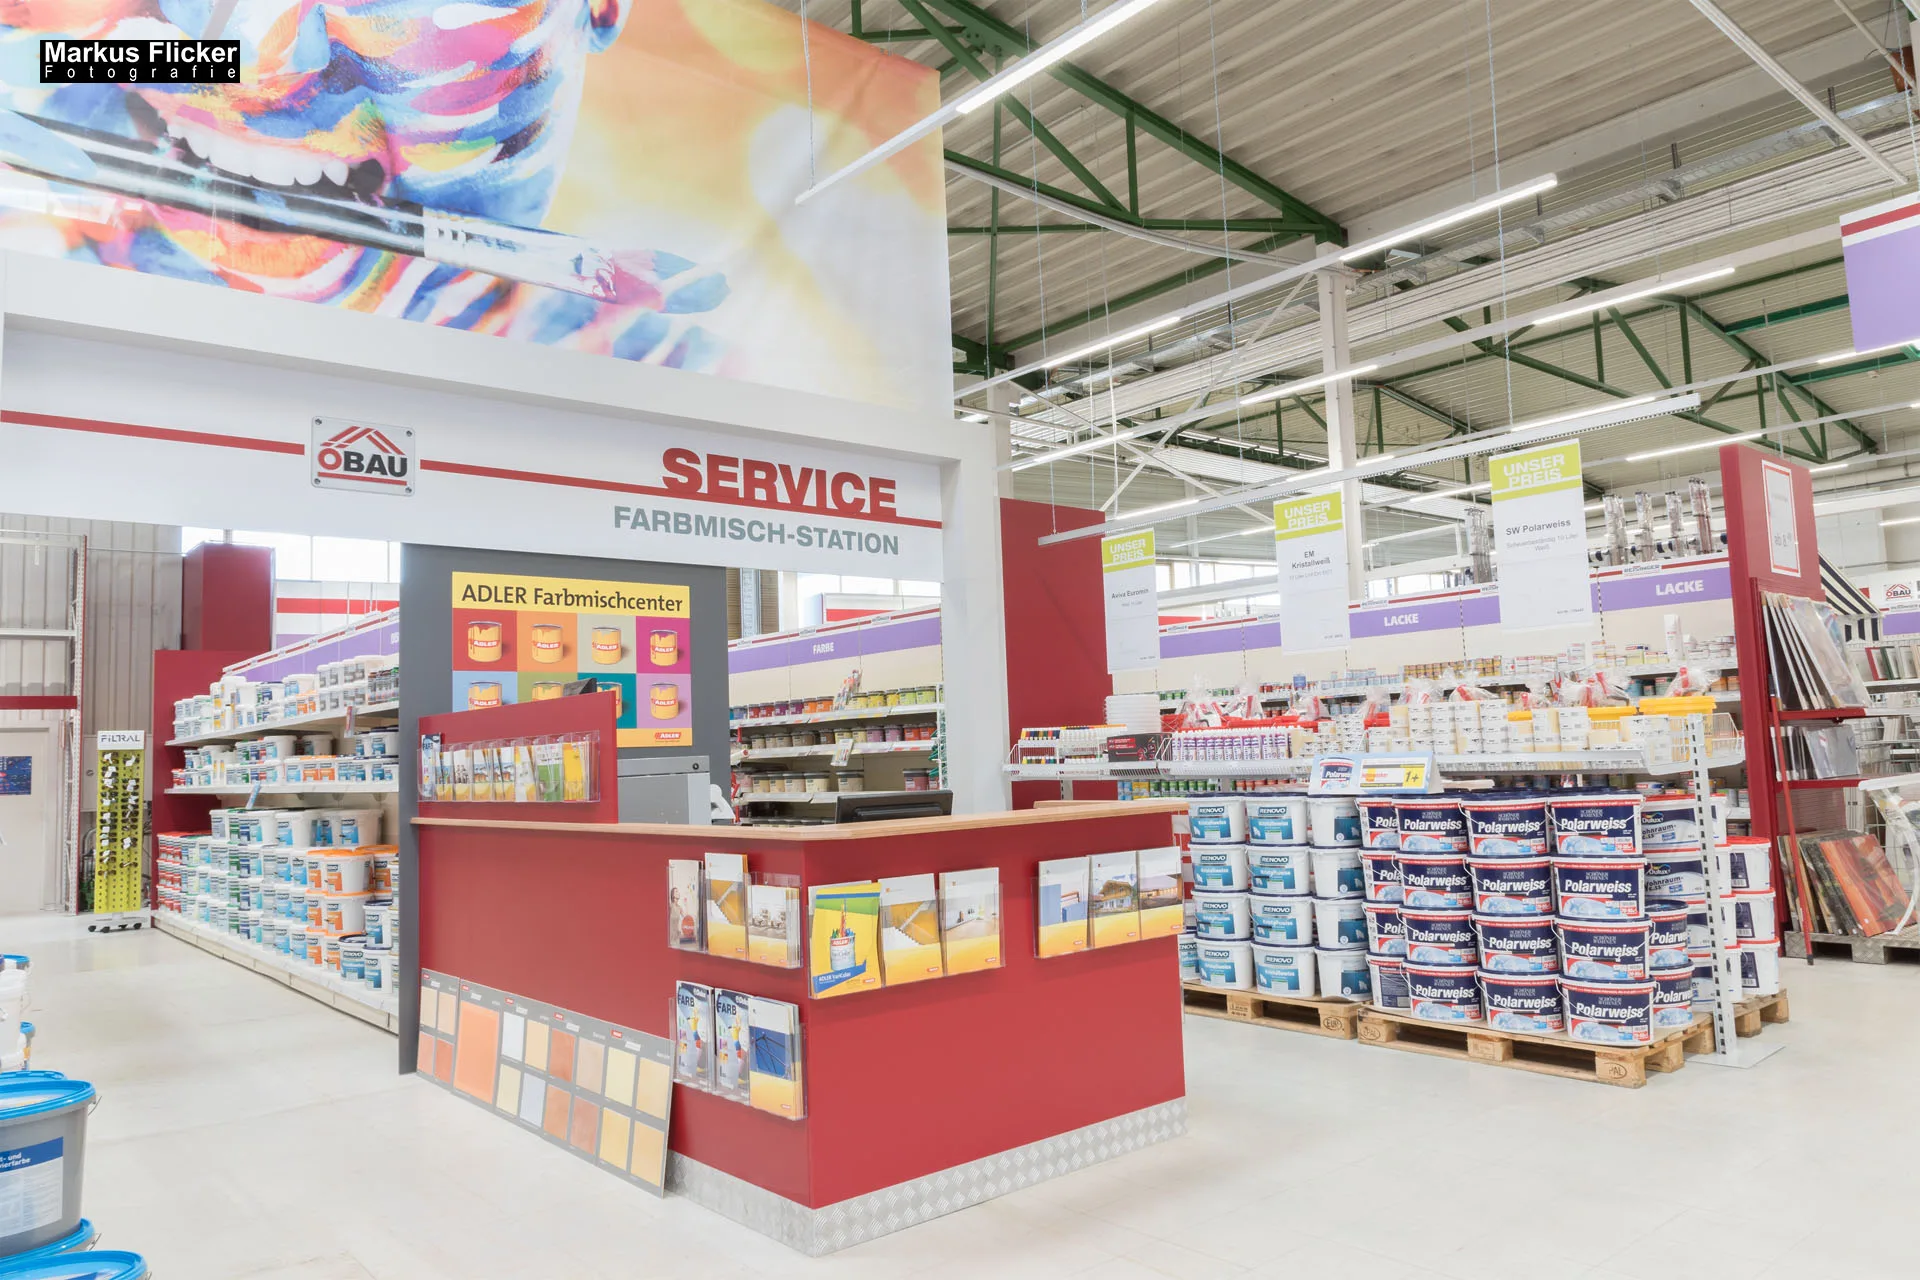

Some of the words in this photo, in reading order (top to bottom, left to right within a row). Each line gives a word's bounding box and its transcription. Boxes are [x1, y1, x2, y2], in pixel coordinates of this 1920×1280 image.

[1503, 453, 1565, 476] UNSER
[662, 447, 896, 517] SERVICE
[1284, 501, 1331, 519] UNSER
[613, 505, 899, 555] FARBMISCH-STATION
[1505, 526, 1521, 536] SW
[1522, 519, 1572, 534] Polarweiss
[1109, 538, 1146, 554] UNSER
[1304, 550, 1315, 558] EM
[1655, 580, 1705, 596] LACKE
[462, 584, 527, 604] ADLER
[534, 588, 683, 612] Farbmischcenter
[1384, 613, 1419, 627] LACKE
[812, 642, 835, 655] FARBE
[1404, 819, 1462, 830] Polarweiss
[1478, 819, 1541, 834] Polarweiss
[1561, 817, 1627, 831] Polarweiss
[1642, 816, 1663, 824] Dulux
[1408, 873, 1467, 886] Polarweiss
[1483, 878, 1546, 892] Polarweiss
[1565, 879, 1632, 893] Polarweiss
[1412, 929, 1471, 942] Polarweiss
[1489, 937, 1552, 951] Polarweiss
[1571, 942, 1639, 957] Polarweiss
[1416, 984, 1475, 998] Polarweiss
[678, 993, 695, 1007] FARB
[1494, 994, 1557, 1009] Polarweiss
[717, 1001, 737, 1016] FARB
[1576, 1002, 1643, 1018] Polarweiss
[8, 1152, 22, 1161] und
